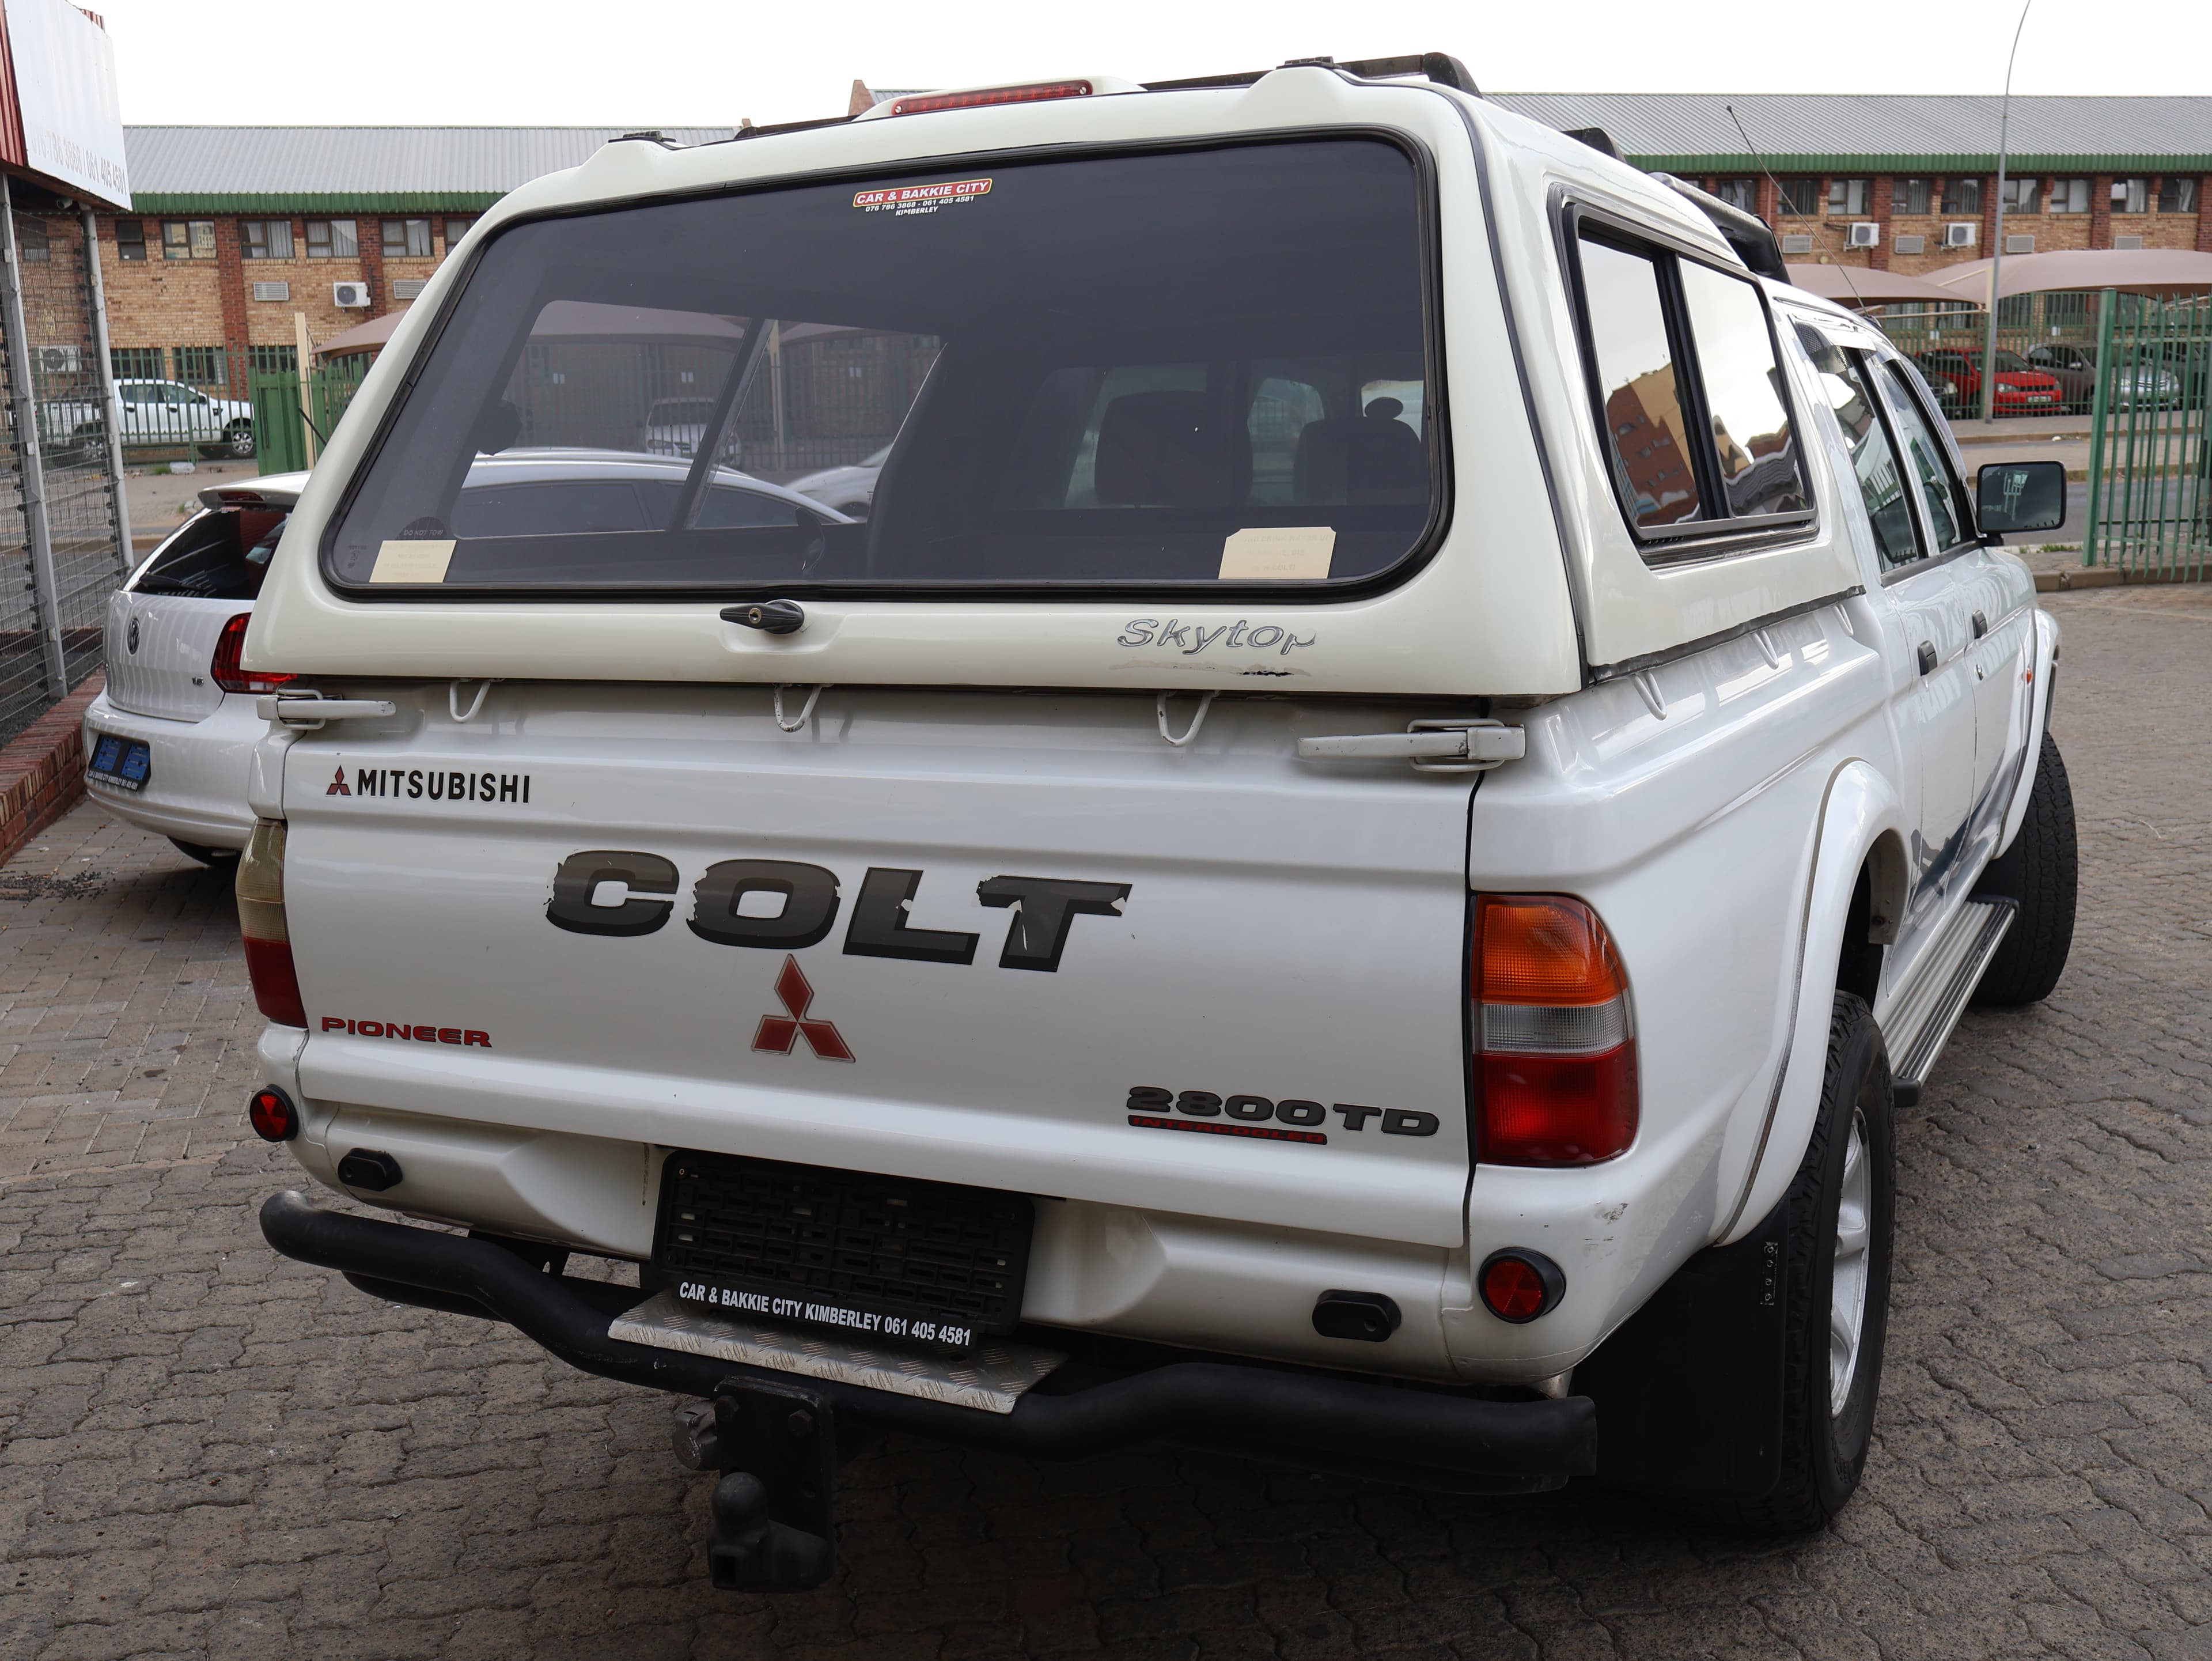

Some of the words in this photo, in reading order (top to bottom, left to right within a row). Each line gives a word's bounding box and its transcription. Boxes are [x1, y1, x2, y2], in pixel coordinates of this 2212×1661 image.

[63, 138, 82, 176] 3868
[85, 149, 100, 183] 061
[100, 157, 112, 190] 405
[112, 163, 127, 196] 4581
[857, 194, 882, 204] CAR
[888, 192, 896, 201] &
[902, 186, 952, 199] BAKKIE
[956, 181, 988, 194] CITY
[895, 206, 938, 216] KIMBERLEY
[358, 769, 530, 803] MITSUBISHI
[546, 849, 1132, 973] COLT
[322, 1017, 493, 1047] PIONEER
[1132, 1117, 1324, 1143] INTERCOOLED
[679, 1282, 706, 1302] CAR
[709, 1287, 718, 1303] &
[722, 1289, 769, 1312] BAKKIE
[772, 1297, 802, 1317] CITY
[805, 1302, 882, 1331] KIMBERLEY
[884, 1316, 907, 1335] 061
[911, 1321, 935, 1341] 405
[938, 1326, 971, 1346] 4581
